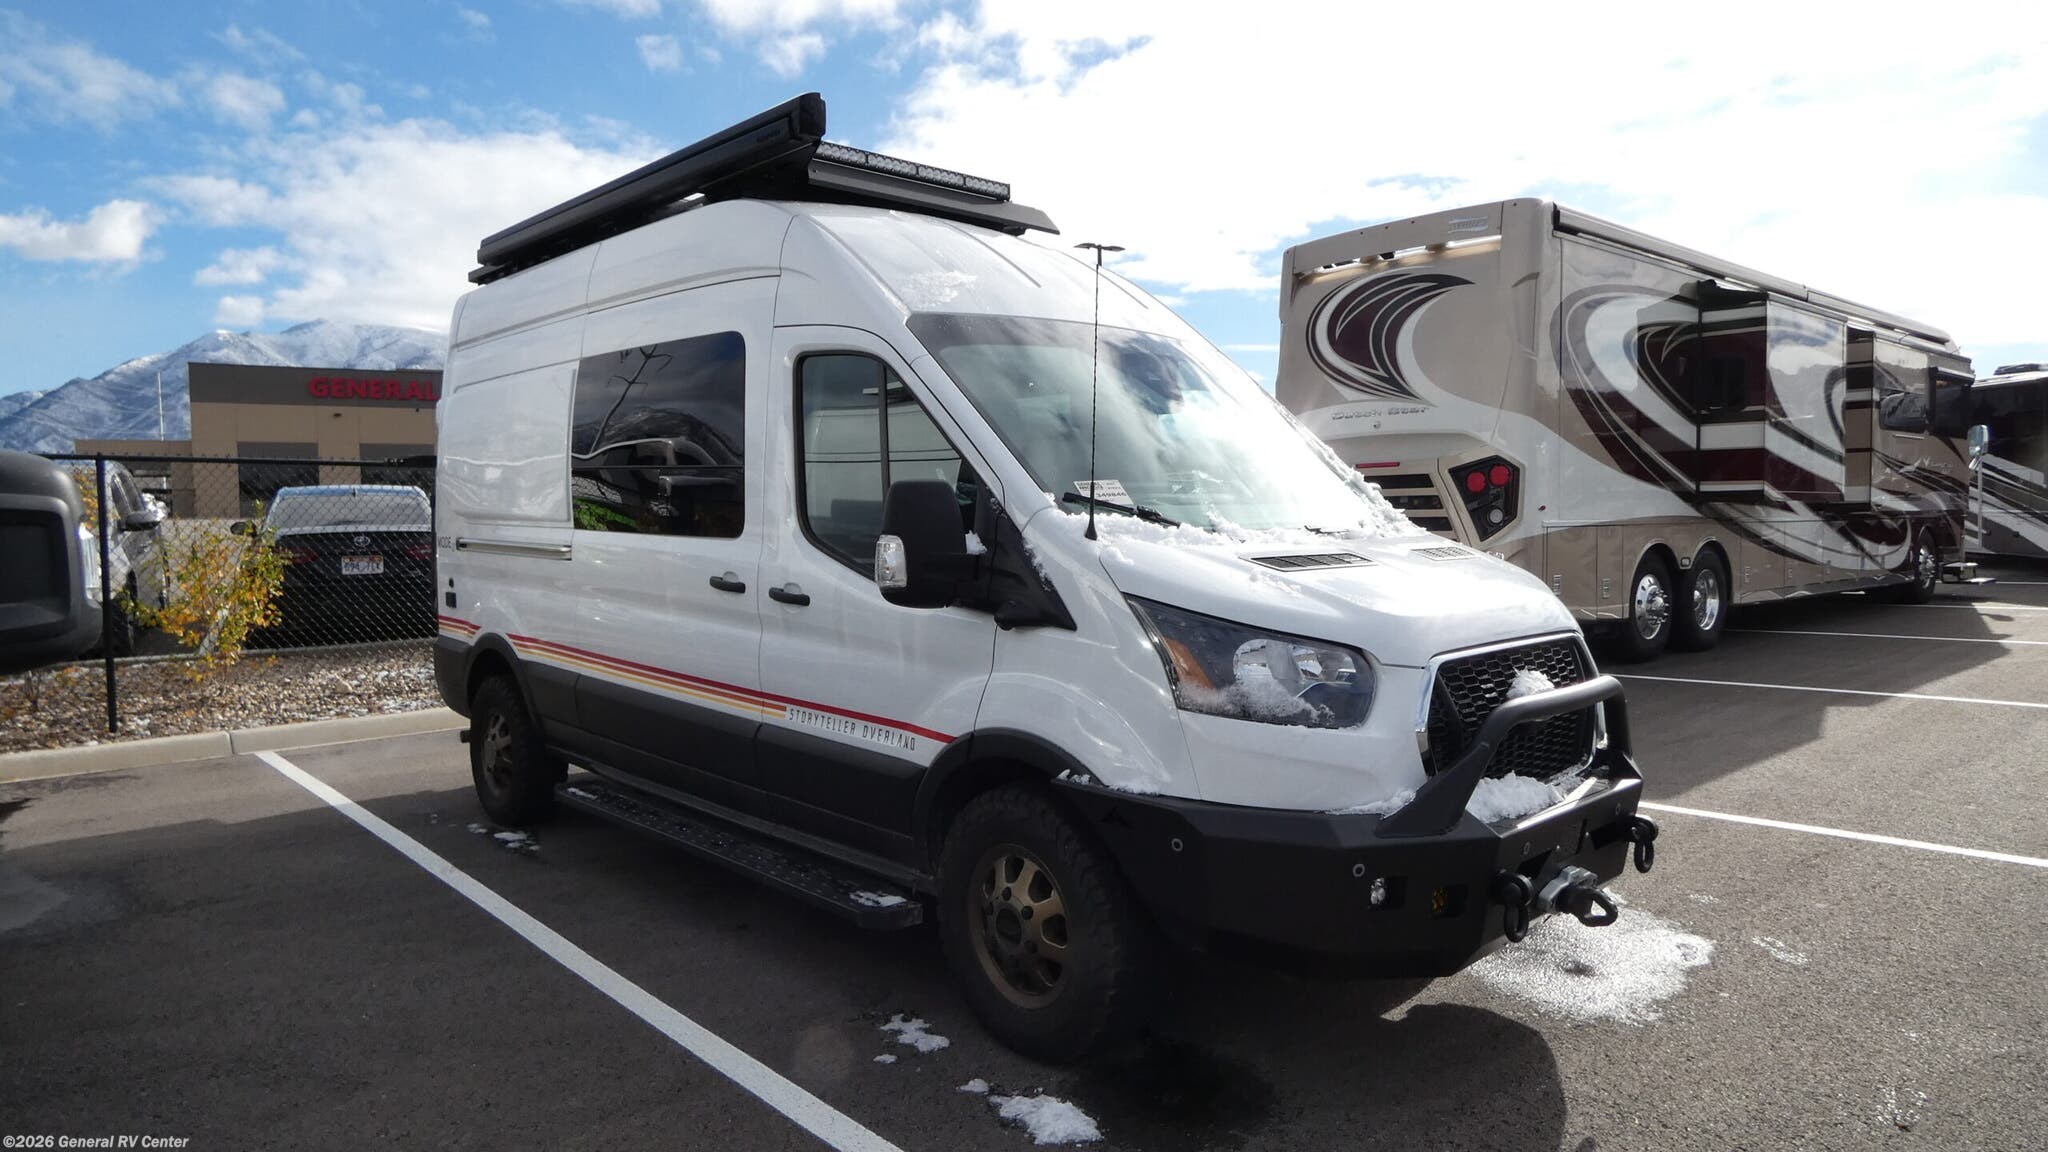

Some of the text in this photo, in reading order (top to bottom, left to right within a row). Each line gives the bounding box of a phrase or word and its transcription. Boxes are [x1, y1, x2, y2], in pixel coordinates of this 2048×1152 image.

[308, 376, 439, 401] GENERAL
[789, 708, 916, 751] STORYTELLER OVERLAND
